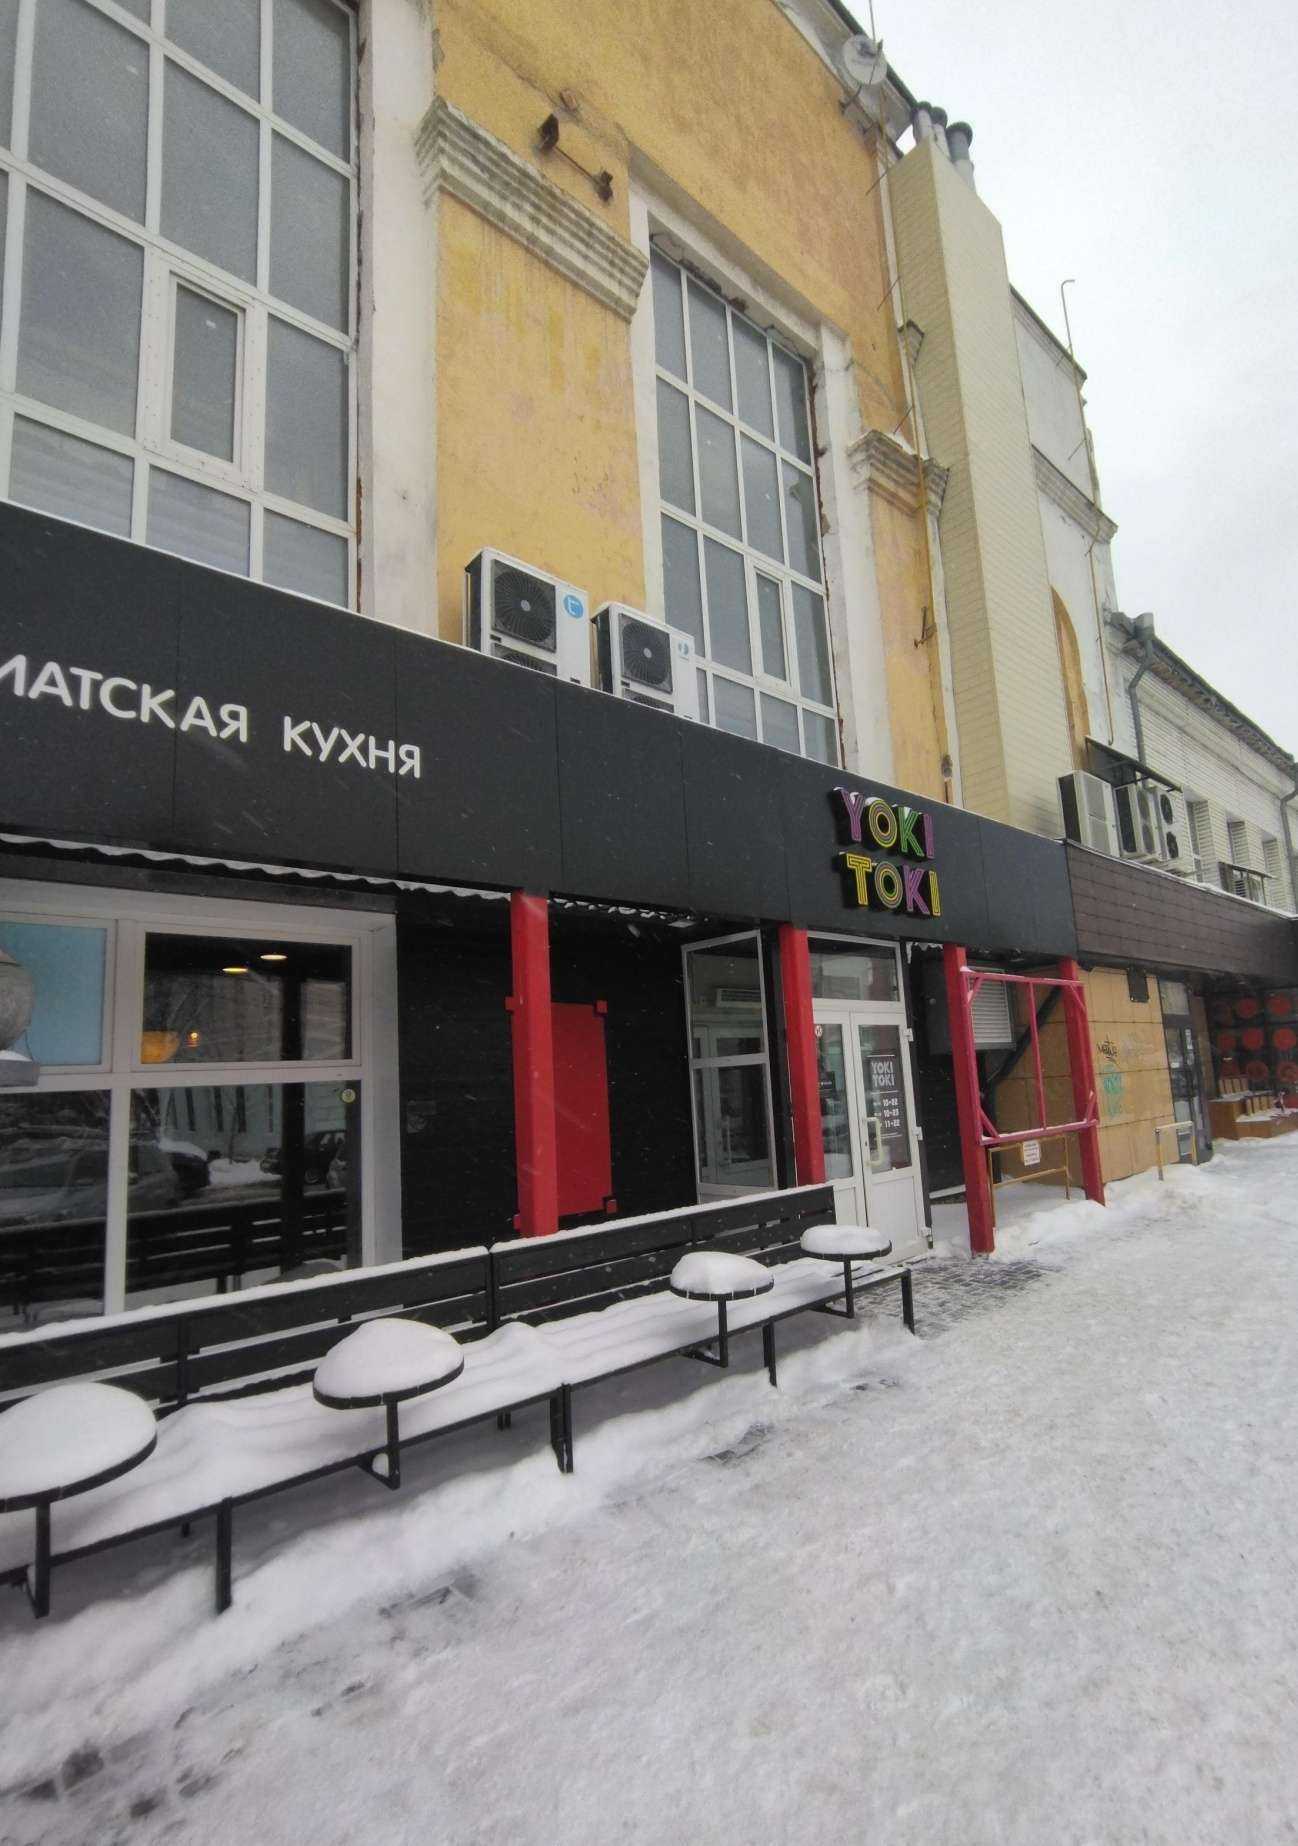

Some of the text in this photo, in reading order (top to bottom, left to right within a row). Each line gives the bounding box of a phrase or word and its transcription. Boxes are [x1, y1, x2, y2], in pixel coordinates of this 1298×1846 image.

[283, 716, 421, 778] КУХНЯ
[838, 787, 934, 859] YOKI
[844, 852, 941, 916] TOKI
[871, 1061, 893, 1073] YOKI
